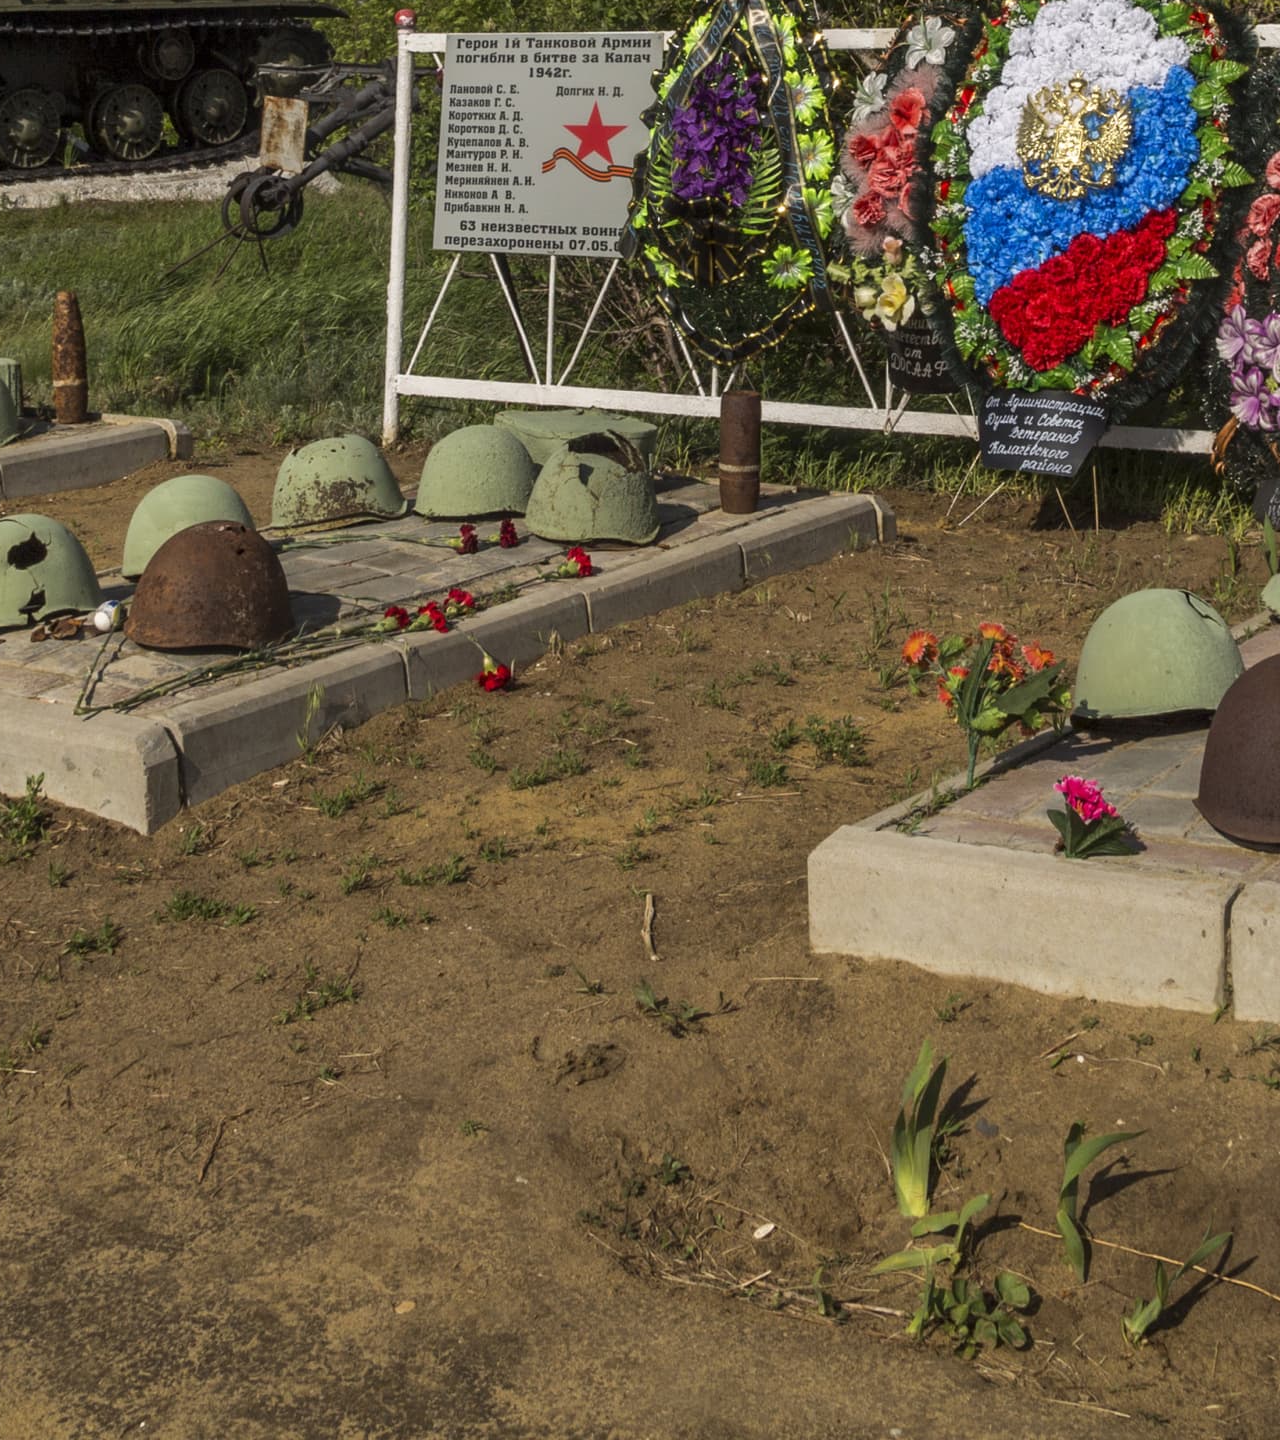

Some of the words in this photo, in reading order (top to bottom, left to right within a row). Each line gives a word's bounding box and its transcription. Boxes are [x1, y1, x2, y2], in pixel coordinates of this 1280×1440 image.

[457, 38, 498, 50] Герои
[505, 38, 519, 48] 1й
[526, 37, 596, 49] Танковой
[602, 38, 651, 50] Армии
[456, 52, 515, 64] погибли
[520, 54, 528, 63] в
[534, 52, 577, 63] битве
[582, 54, 599, 63] за
[604, 52, 651, 63] Калач
[529, 68, 572, 78] 1942г.
[450, 85, 493, 94] Лановой
[556, 87, 594, 97] Долгих
[449, 98, 490, 107] Казаков
[449, 111, 496, 122] Коротких
[448, 124, 495, 135] Коротков
[447, 150, 496, 161] Мантуров
[445, 189, 488, 199] Никонов
[460, 221, 476, 231] 63
[481, 223, 577, 235] неизвестных
[445, 235, 564, 250] перезахоронены
